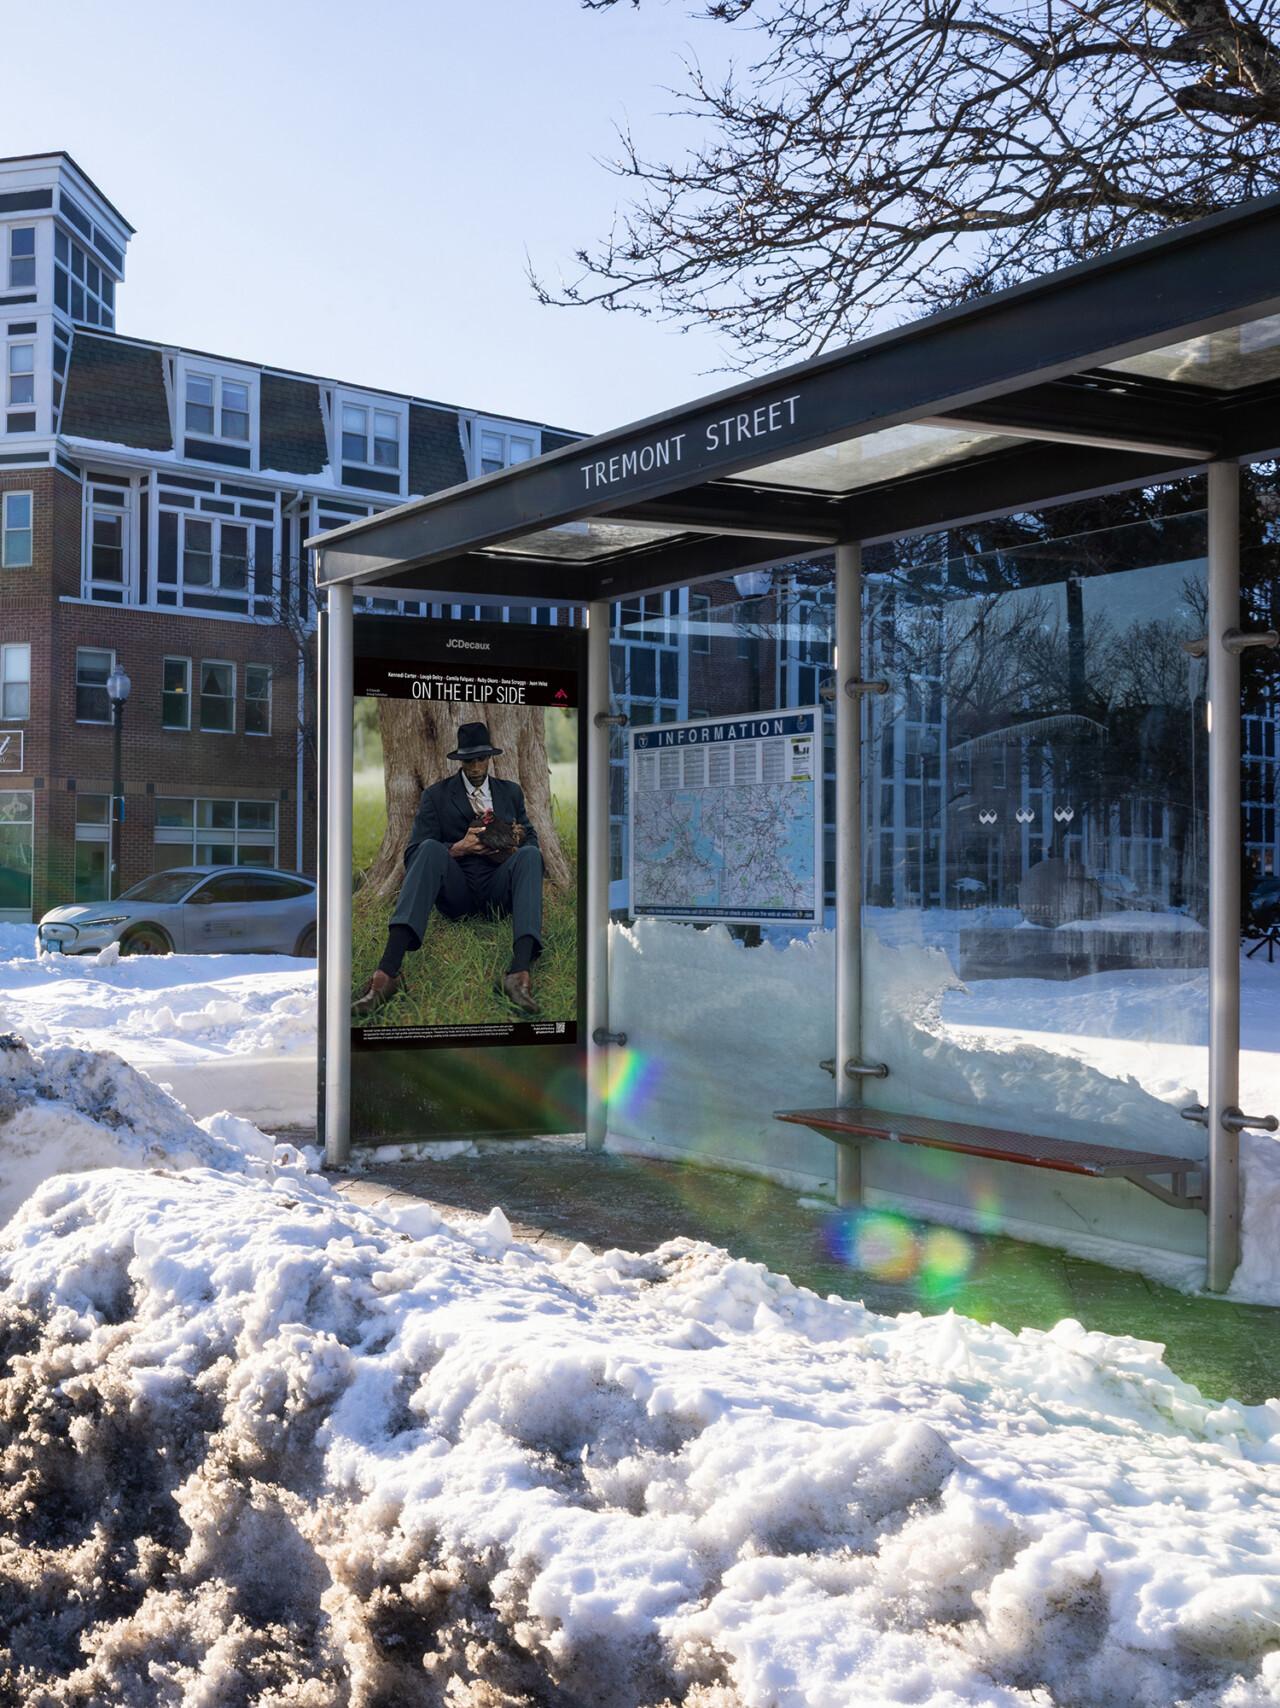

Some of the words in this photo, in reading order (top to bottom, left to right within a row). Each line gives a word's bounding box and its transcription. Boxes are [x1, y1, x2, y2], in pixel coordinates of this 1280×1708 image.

[580, 433, 687, 490] TREMONT
[706, 394, 801, 452] STREET
[445, 638, 491, 651] JCDecaux
[412, 680, 432, 700] ON
[435, 682, 462, 702] THE
[465, 684, 493, 703] FLIP
[496, 686, 526, 705] SIDE
[658, 719, 784, 747] INFORMATION
